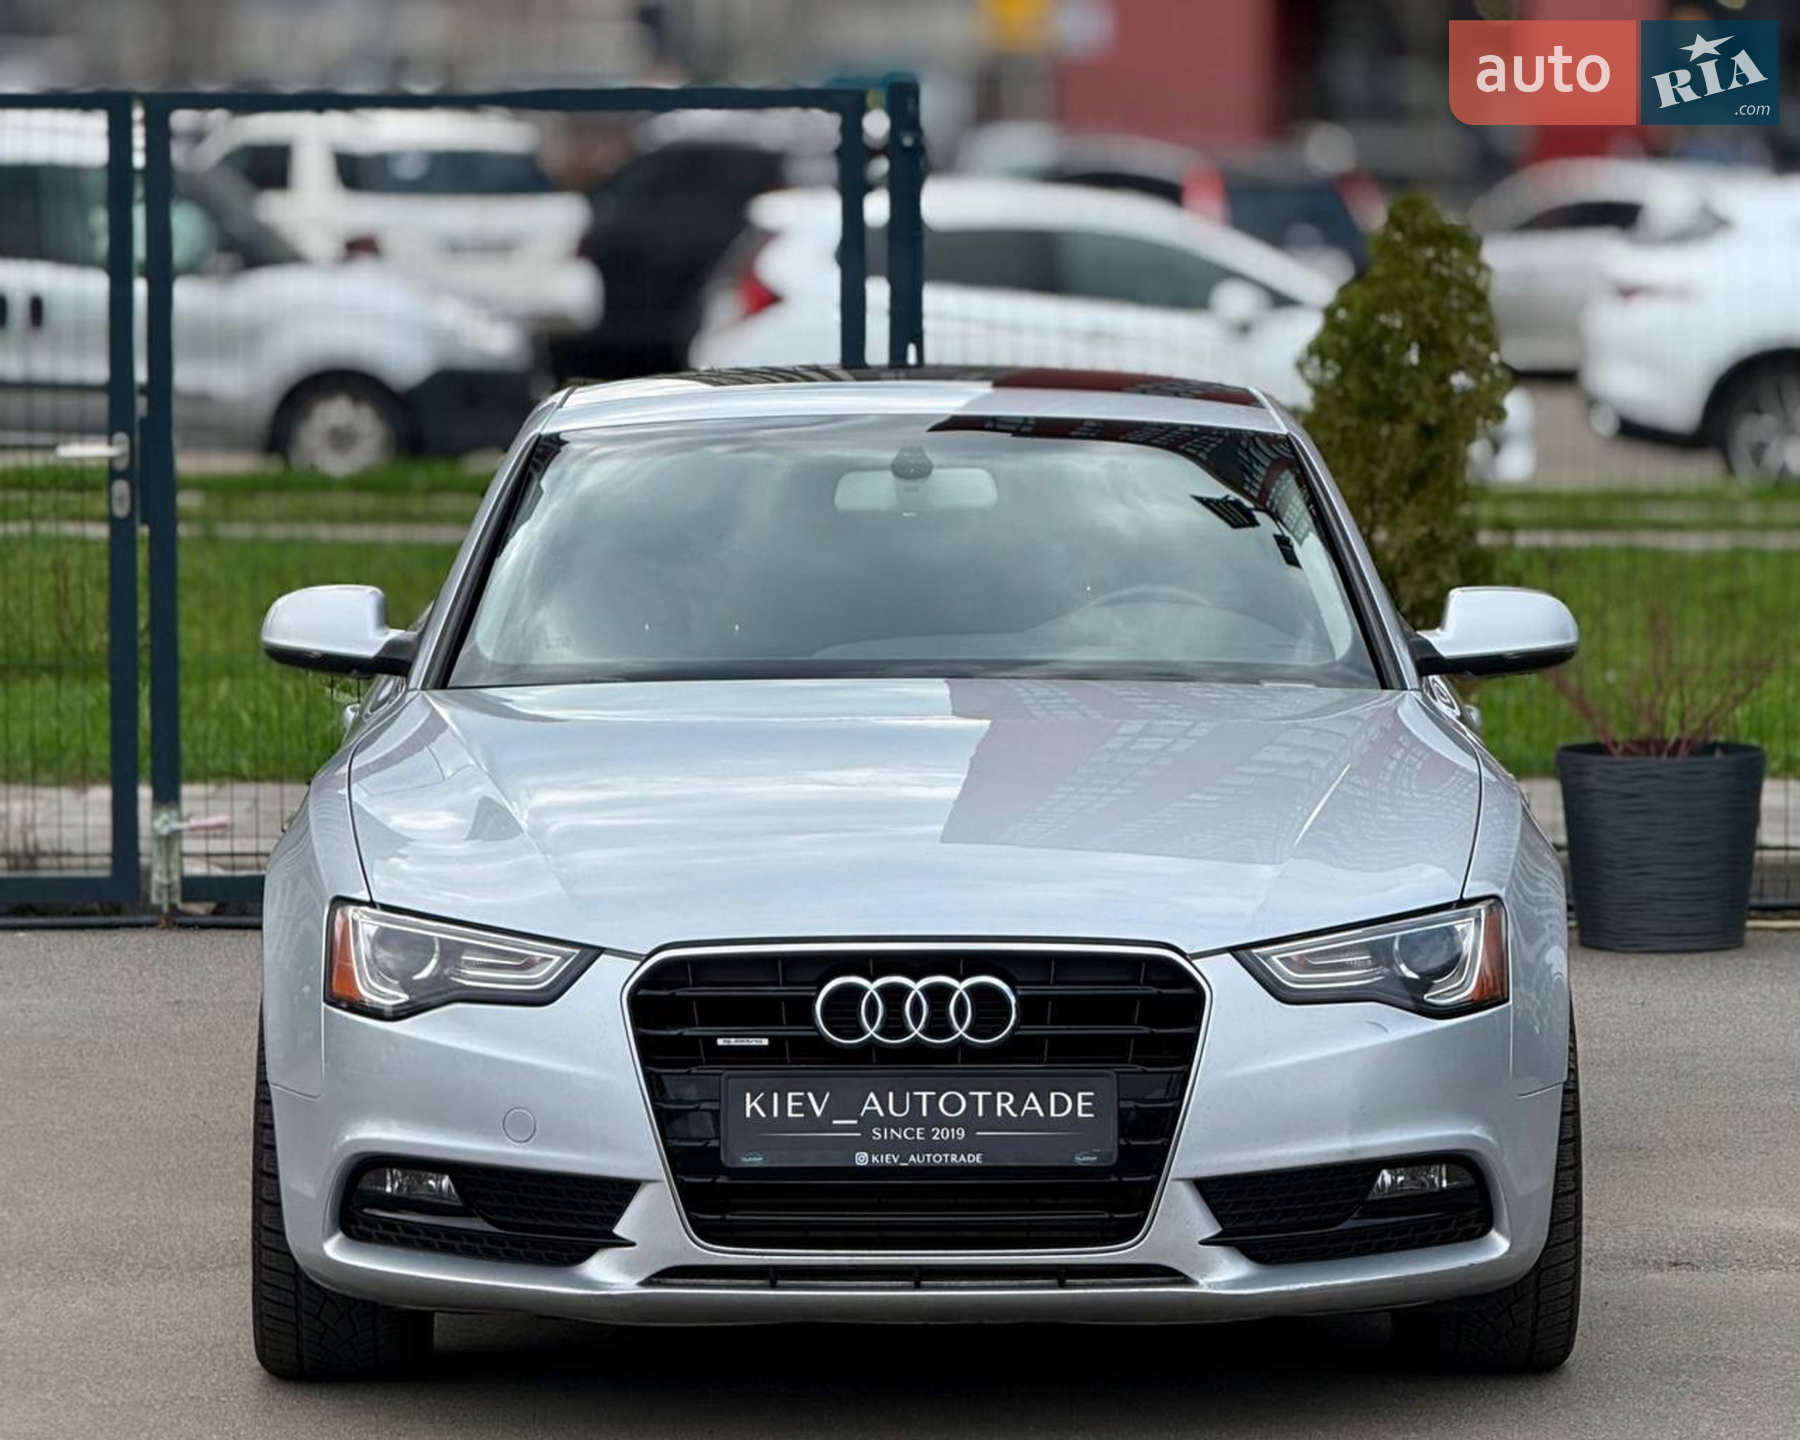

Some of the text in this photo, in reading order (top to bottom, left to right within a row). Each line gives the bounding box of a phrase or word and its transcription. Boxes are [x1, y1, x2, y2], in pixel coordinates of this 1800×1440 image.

[745, 1091, 1095, 1125] KIEV_AUTOTRADE
[871, 1126, 966, 1141] SINCE 2019
[871, 1153, 983, 1166] KIEV_AUTOTRADE
